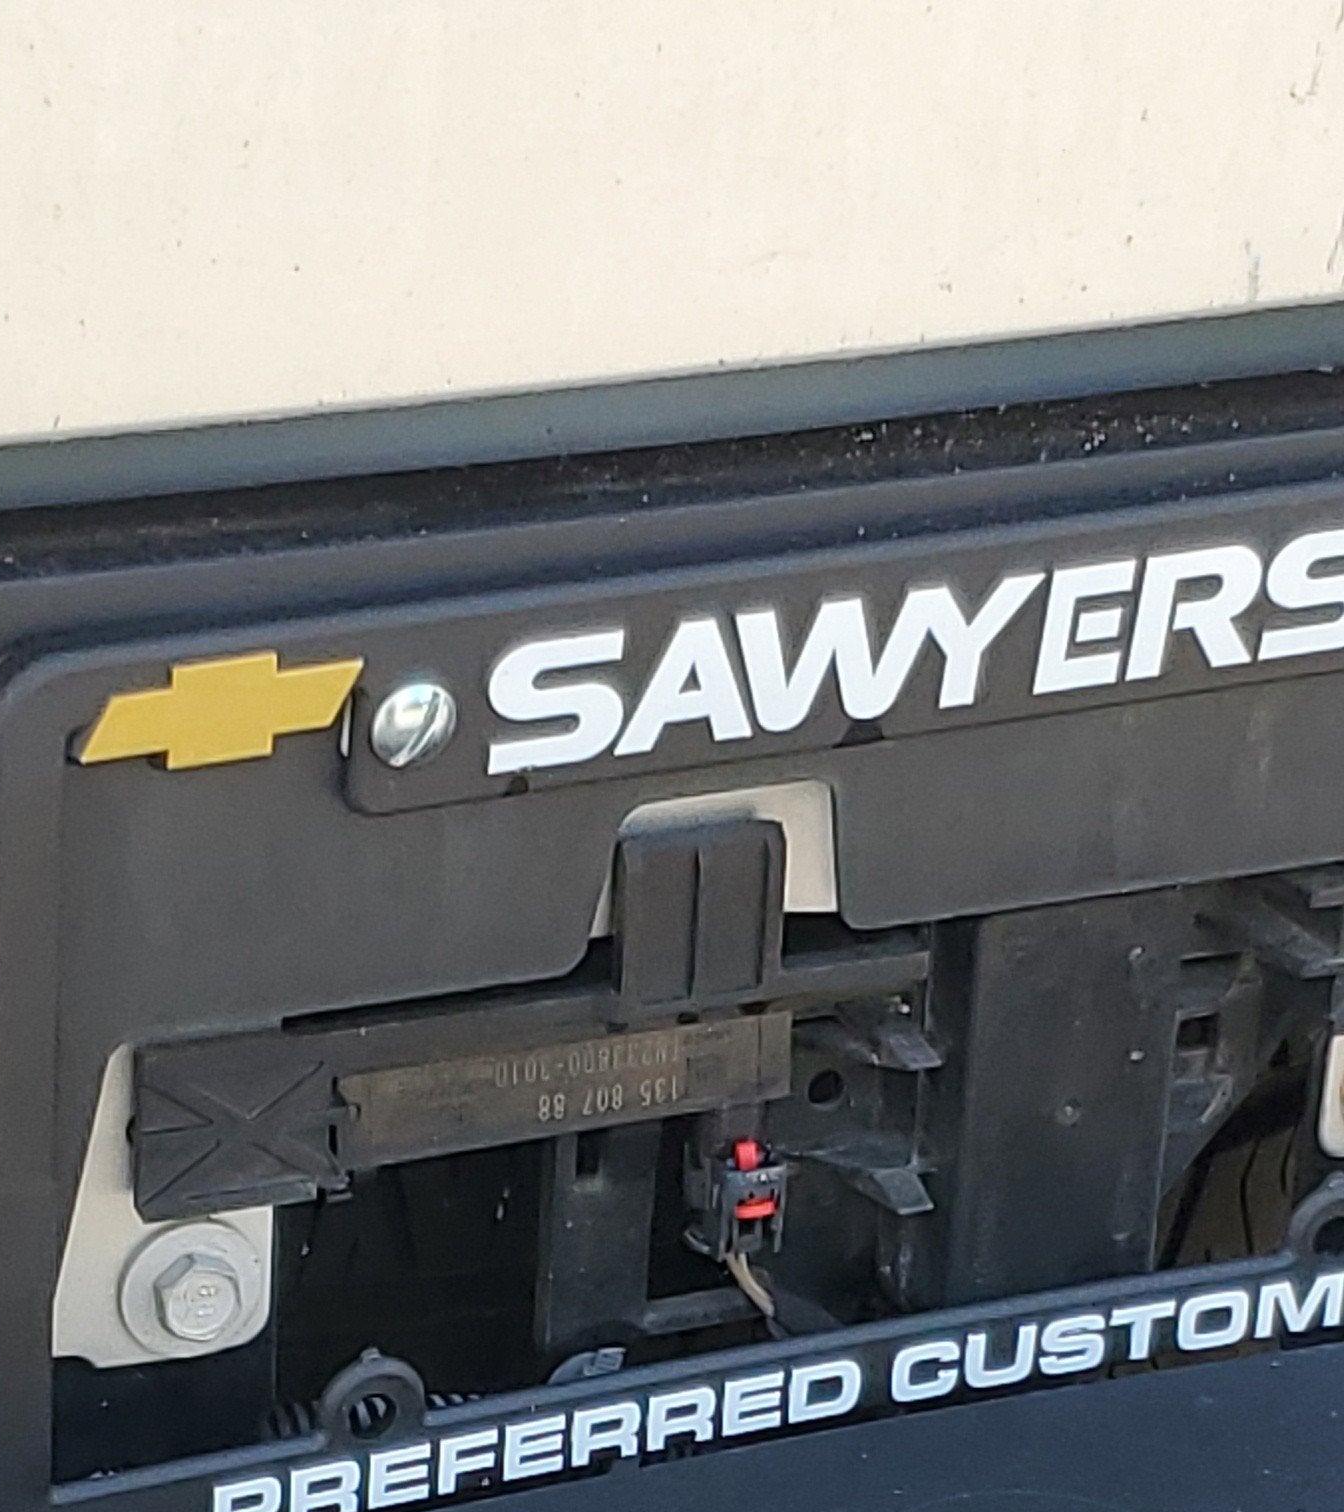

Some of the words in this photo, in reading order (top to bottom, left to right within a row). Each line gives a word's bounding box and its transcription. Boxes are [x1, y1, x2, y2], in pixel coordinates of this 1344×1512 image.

[581, 1083, 624, 1115] 807
[639, 1074, 678, 1107] 135
[537, 1092, 566, 1122] 88
